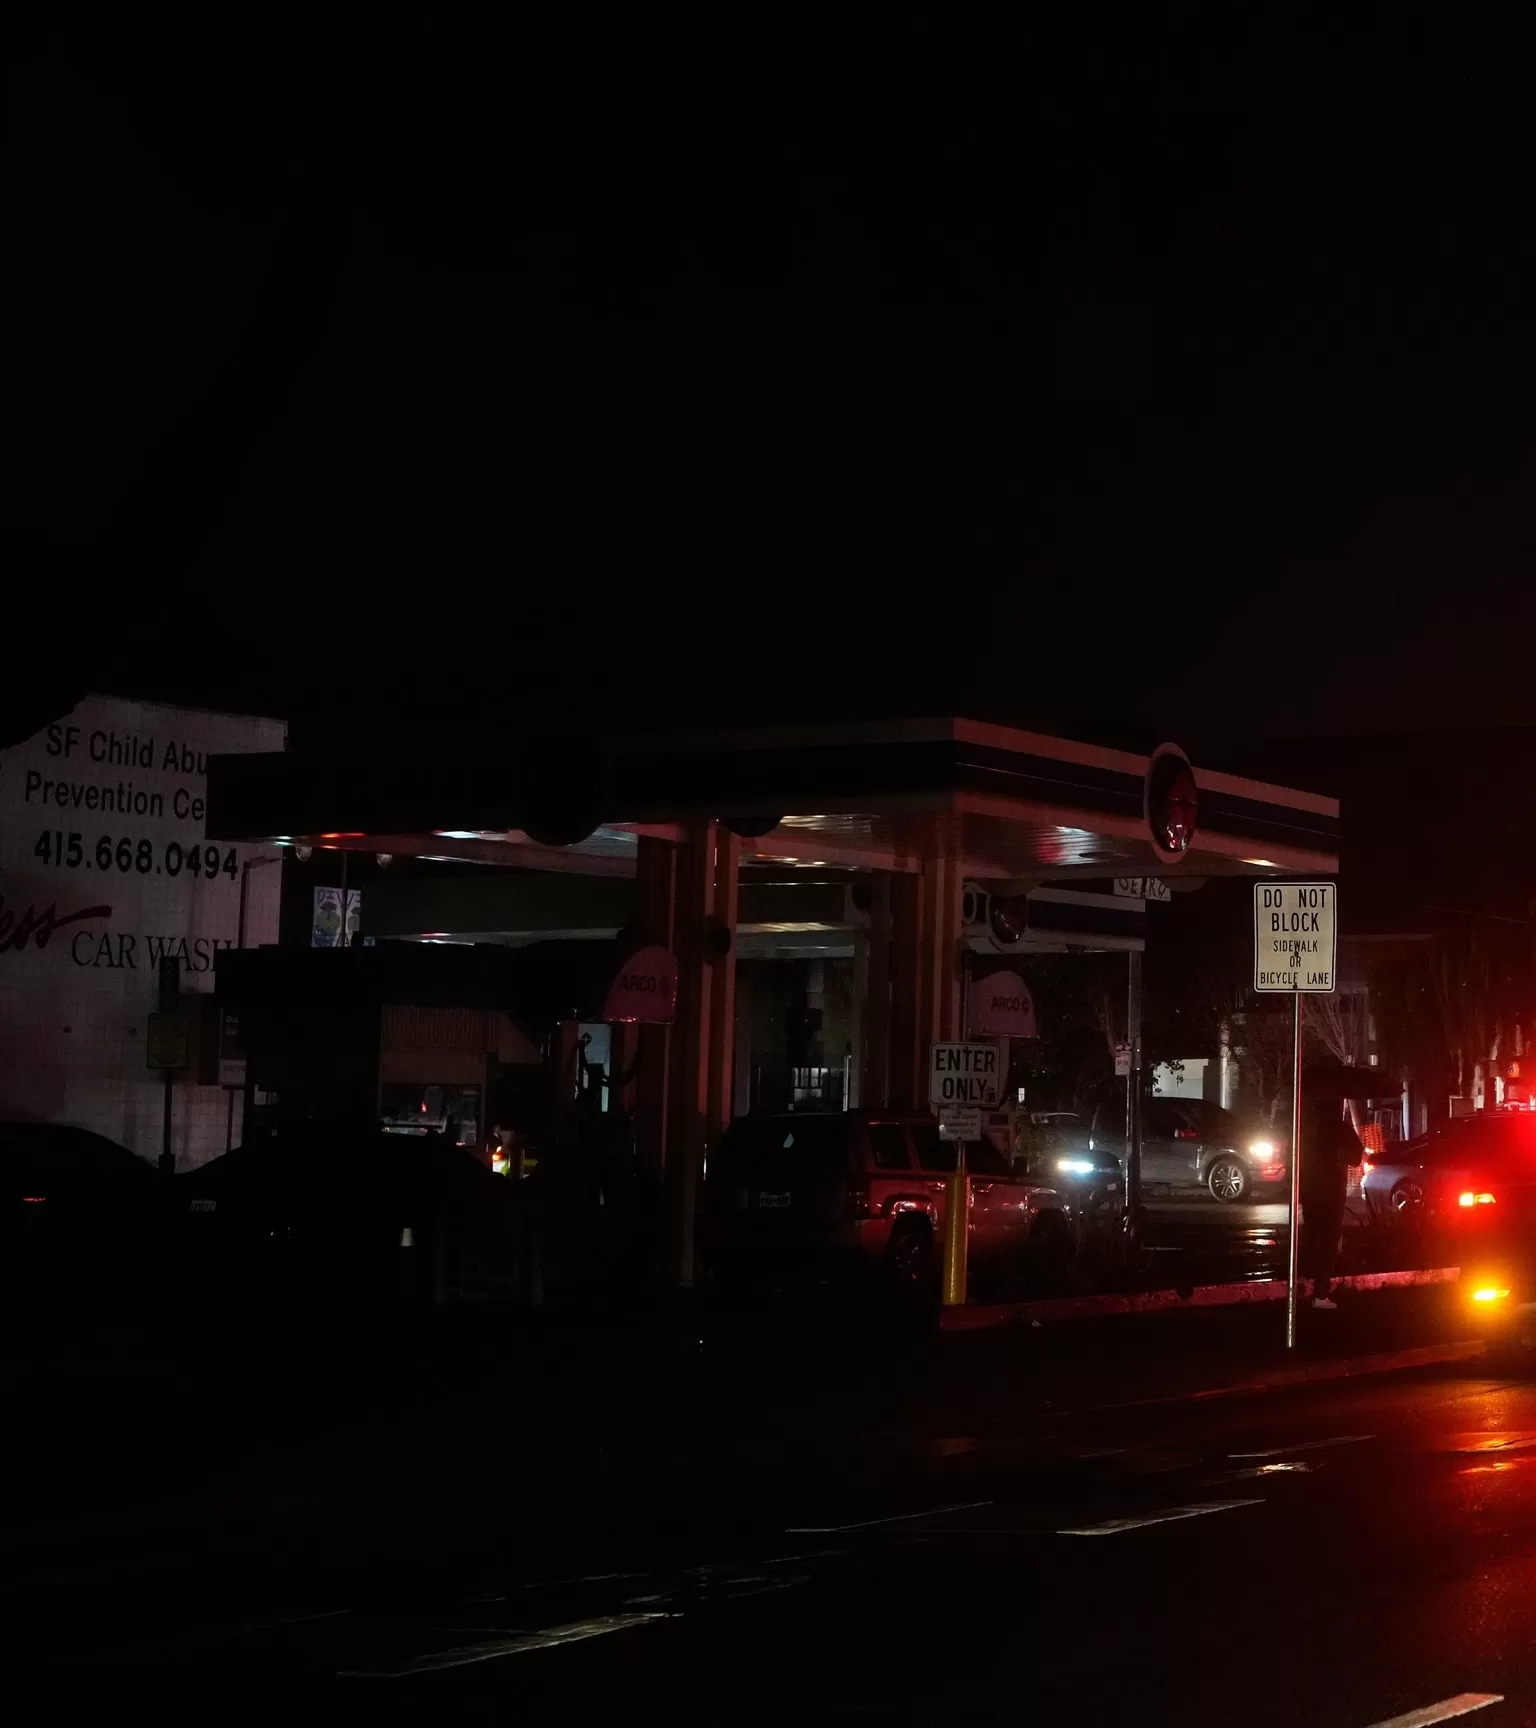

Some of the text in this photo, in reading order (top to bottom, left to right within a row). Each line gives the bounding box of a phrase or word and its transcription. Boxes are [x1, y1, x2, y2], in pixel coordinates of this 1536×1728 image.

[47, 725, 208, 775] SF Child Abu
[25, 770, 205, 820] Prevention Ce
[34, 831, 238, 881] 415.668.0494
[1264, 889, 1326, 908] DO NOT
[1272, 913, 1319, 932] BLOCK
[72, 931, 137, 969] CAR
[1273, 940, 1318, 952] SIDEWALK
[1289, 956, 1301, 967] OR
[620, 974, 656, 993] ARCO
[1261, 972, 1329, 984] BICYCLE LANE
[991, 996, 1019, 1011] ARCO
[936, 1049, 995, 1072] ENTER
[943, 1078, 987, 1101] ONLY
